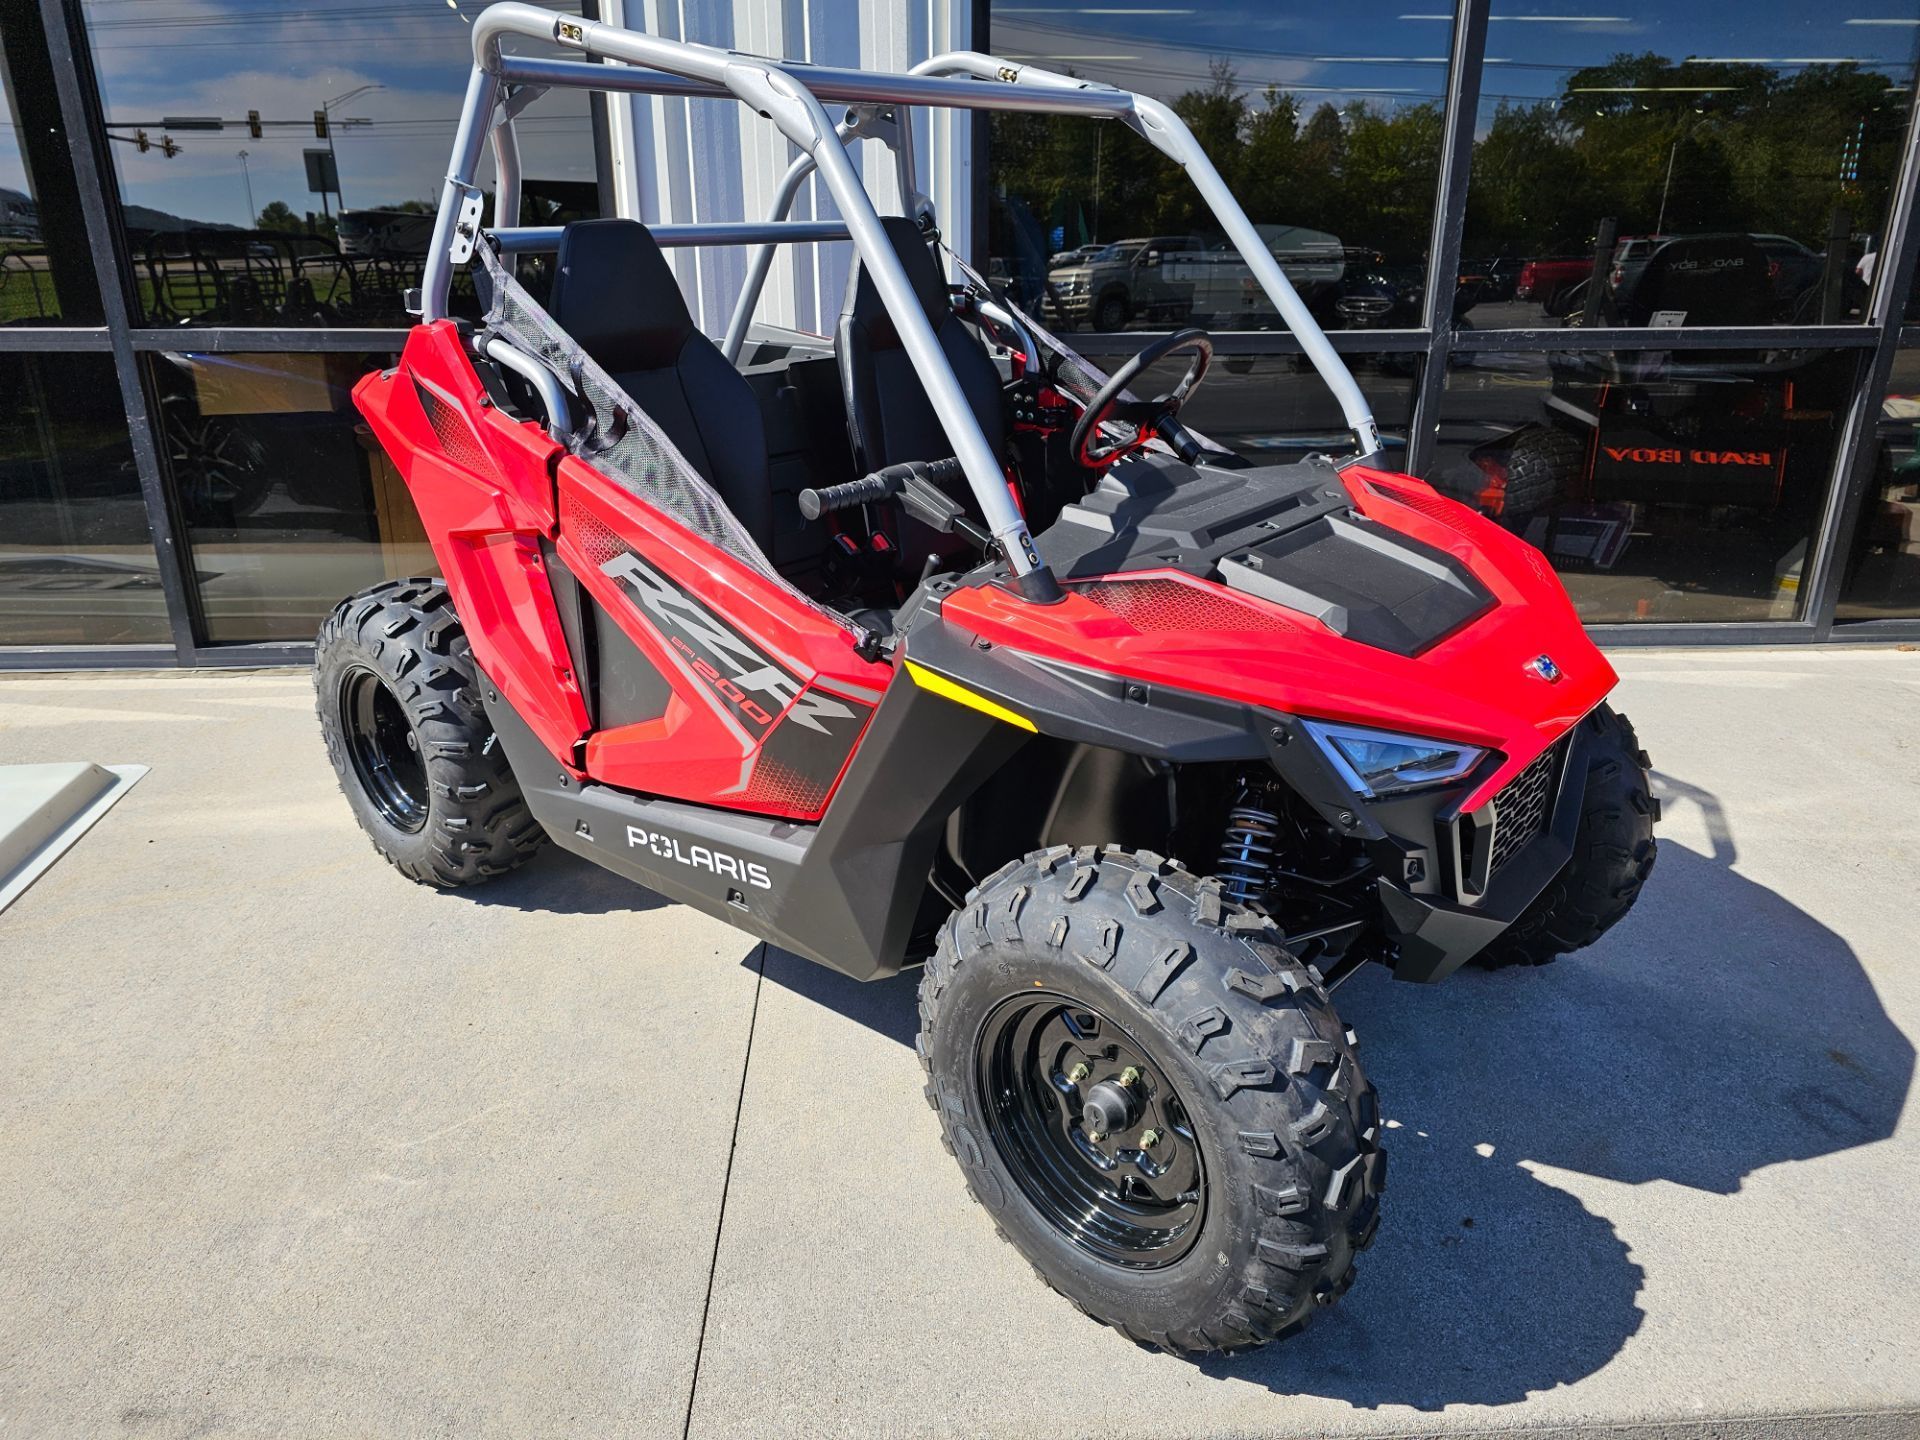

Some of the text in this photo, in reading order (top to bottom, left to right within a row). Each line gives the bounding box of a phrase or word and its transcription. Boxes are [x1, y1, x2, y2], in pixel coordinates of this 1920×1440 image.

[600, 552, 857, 736] RZR
[671, 636, 773, 725] EFI 200
[626, 825, 772, 891] POLARIS
[935, 1073, 1006, 1209] CST
